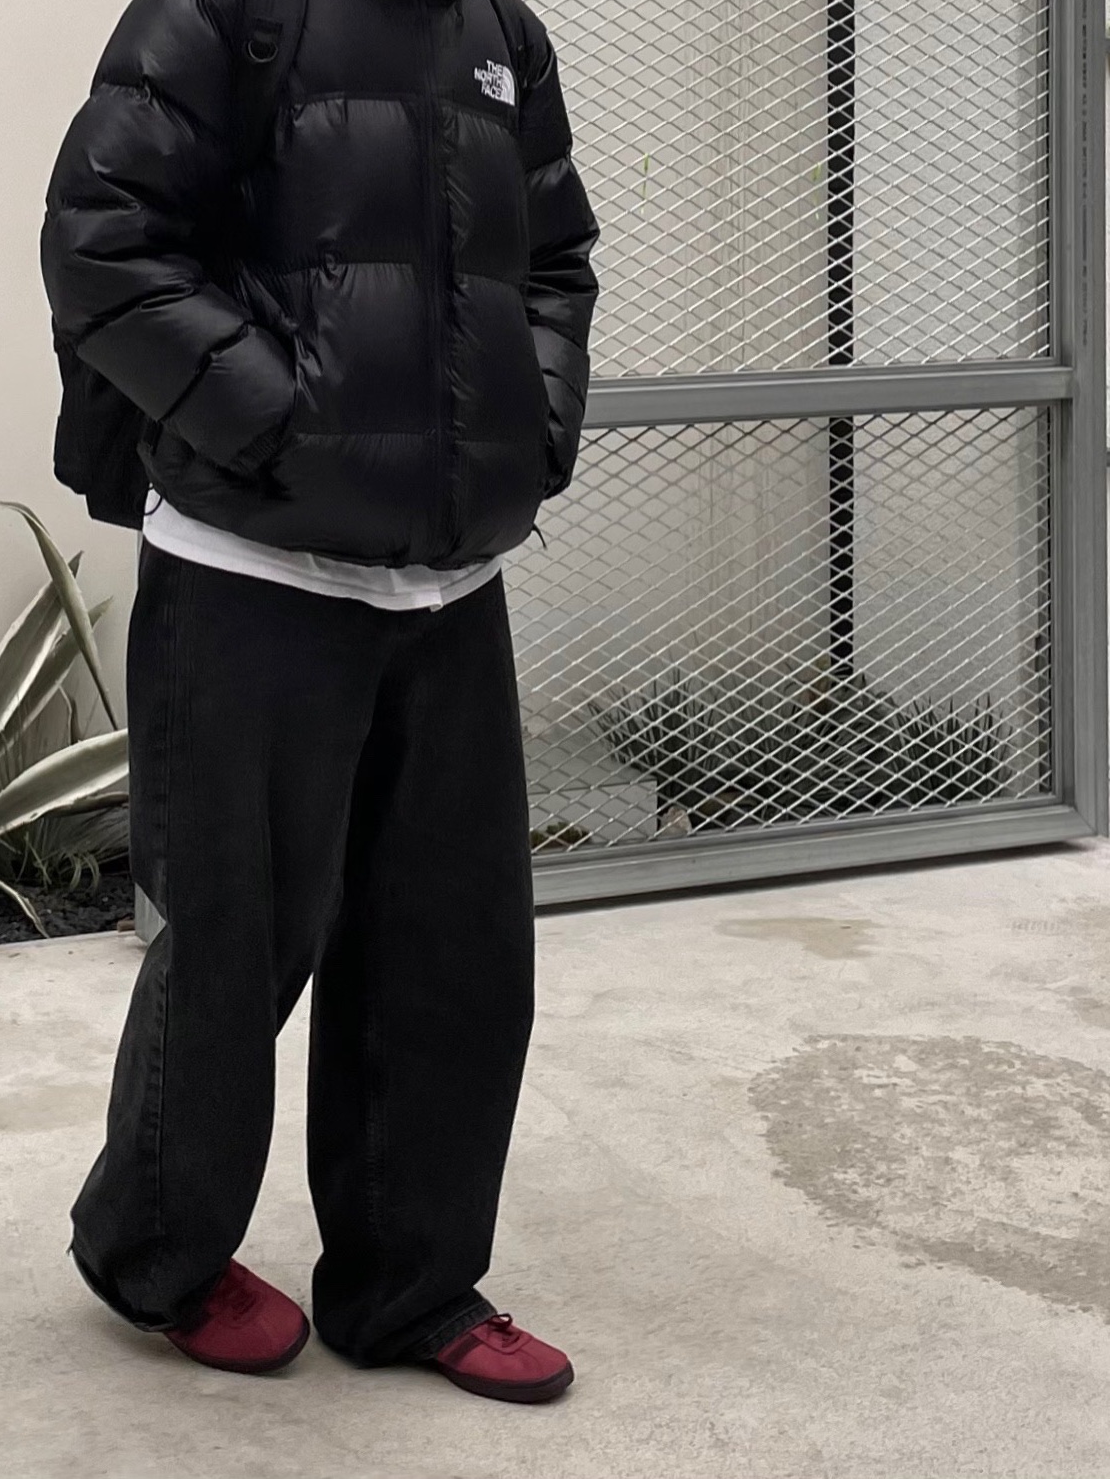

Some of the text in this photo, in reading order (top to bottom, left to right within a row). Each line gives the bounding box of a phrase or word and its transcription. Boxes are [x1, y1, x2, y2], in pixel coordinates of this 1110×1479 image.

[487, 59, 503, 76] THE
[474, 67, 503, 88] NORTH
[481, 82, 503, 99] FACE
